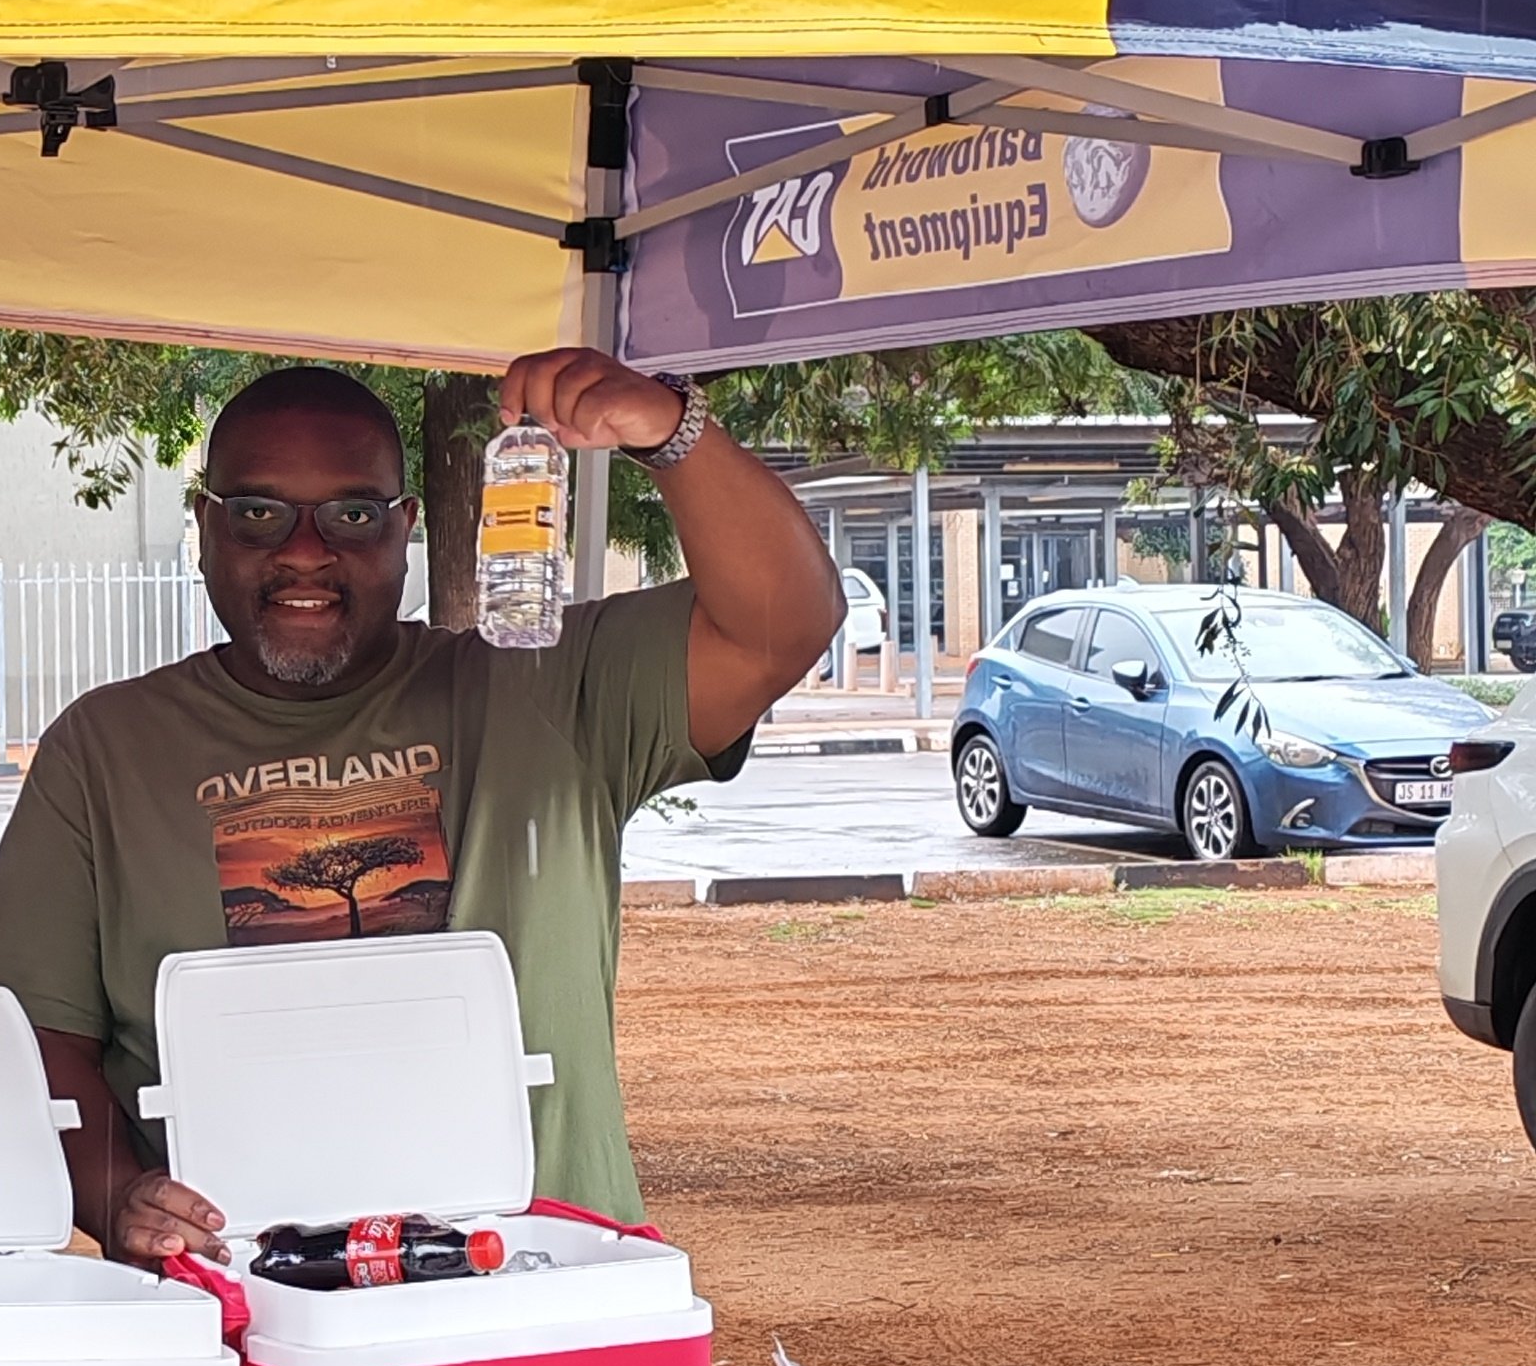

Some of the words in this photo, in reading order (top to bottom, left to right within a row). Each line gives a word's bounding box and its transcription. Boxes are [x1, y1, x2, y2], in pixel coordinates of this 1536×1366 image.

[196, 744, 442, 803] OVERLAND
[1399, 785, 1413, 800] JS
[223, 815, 312, 836] OUTDOOR
